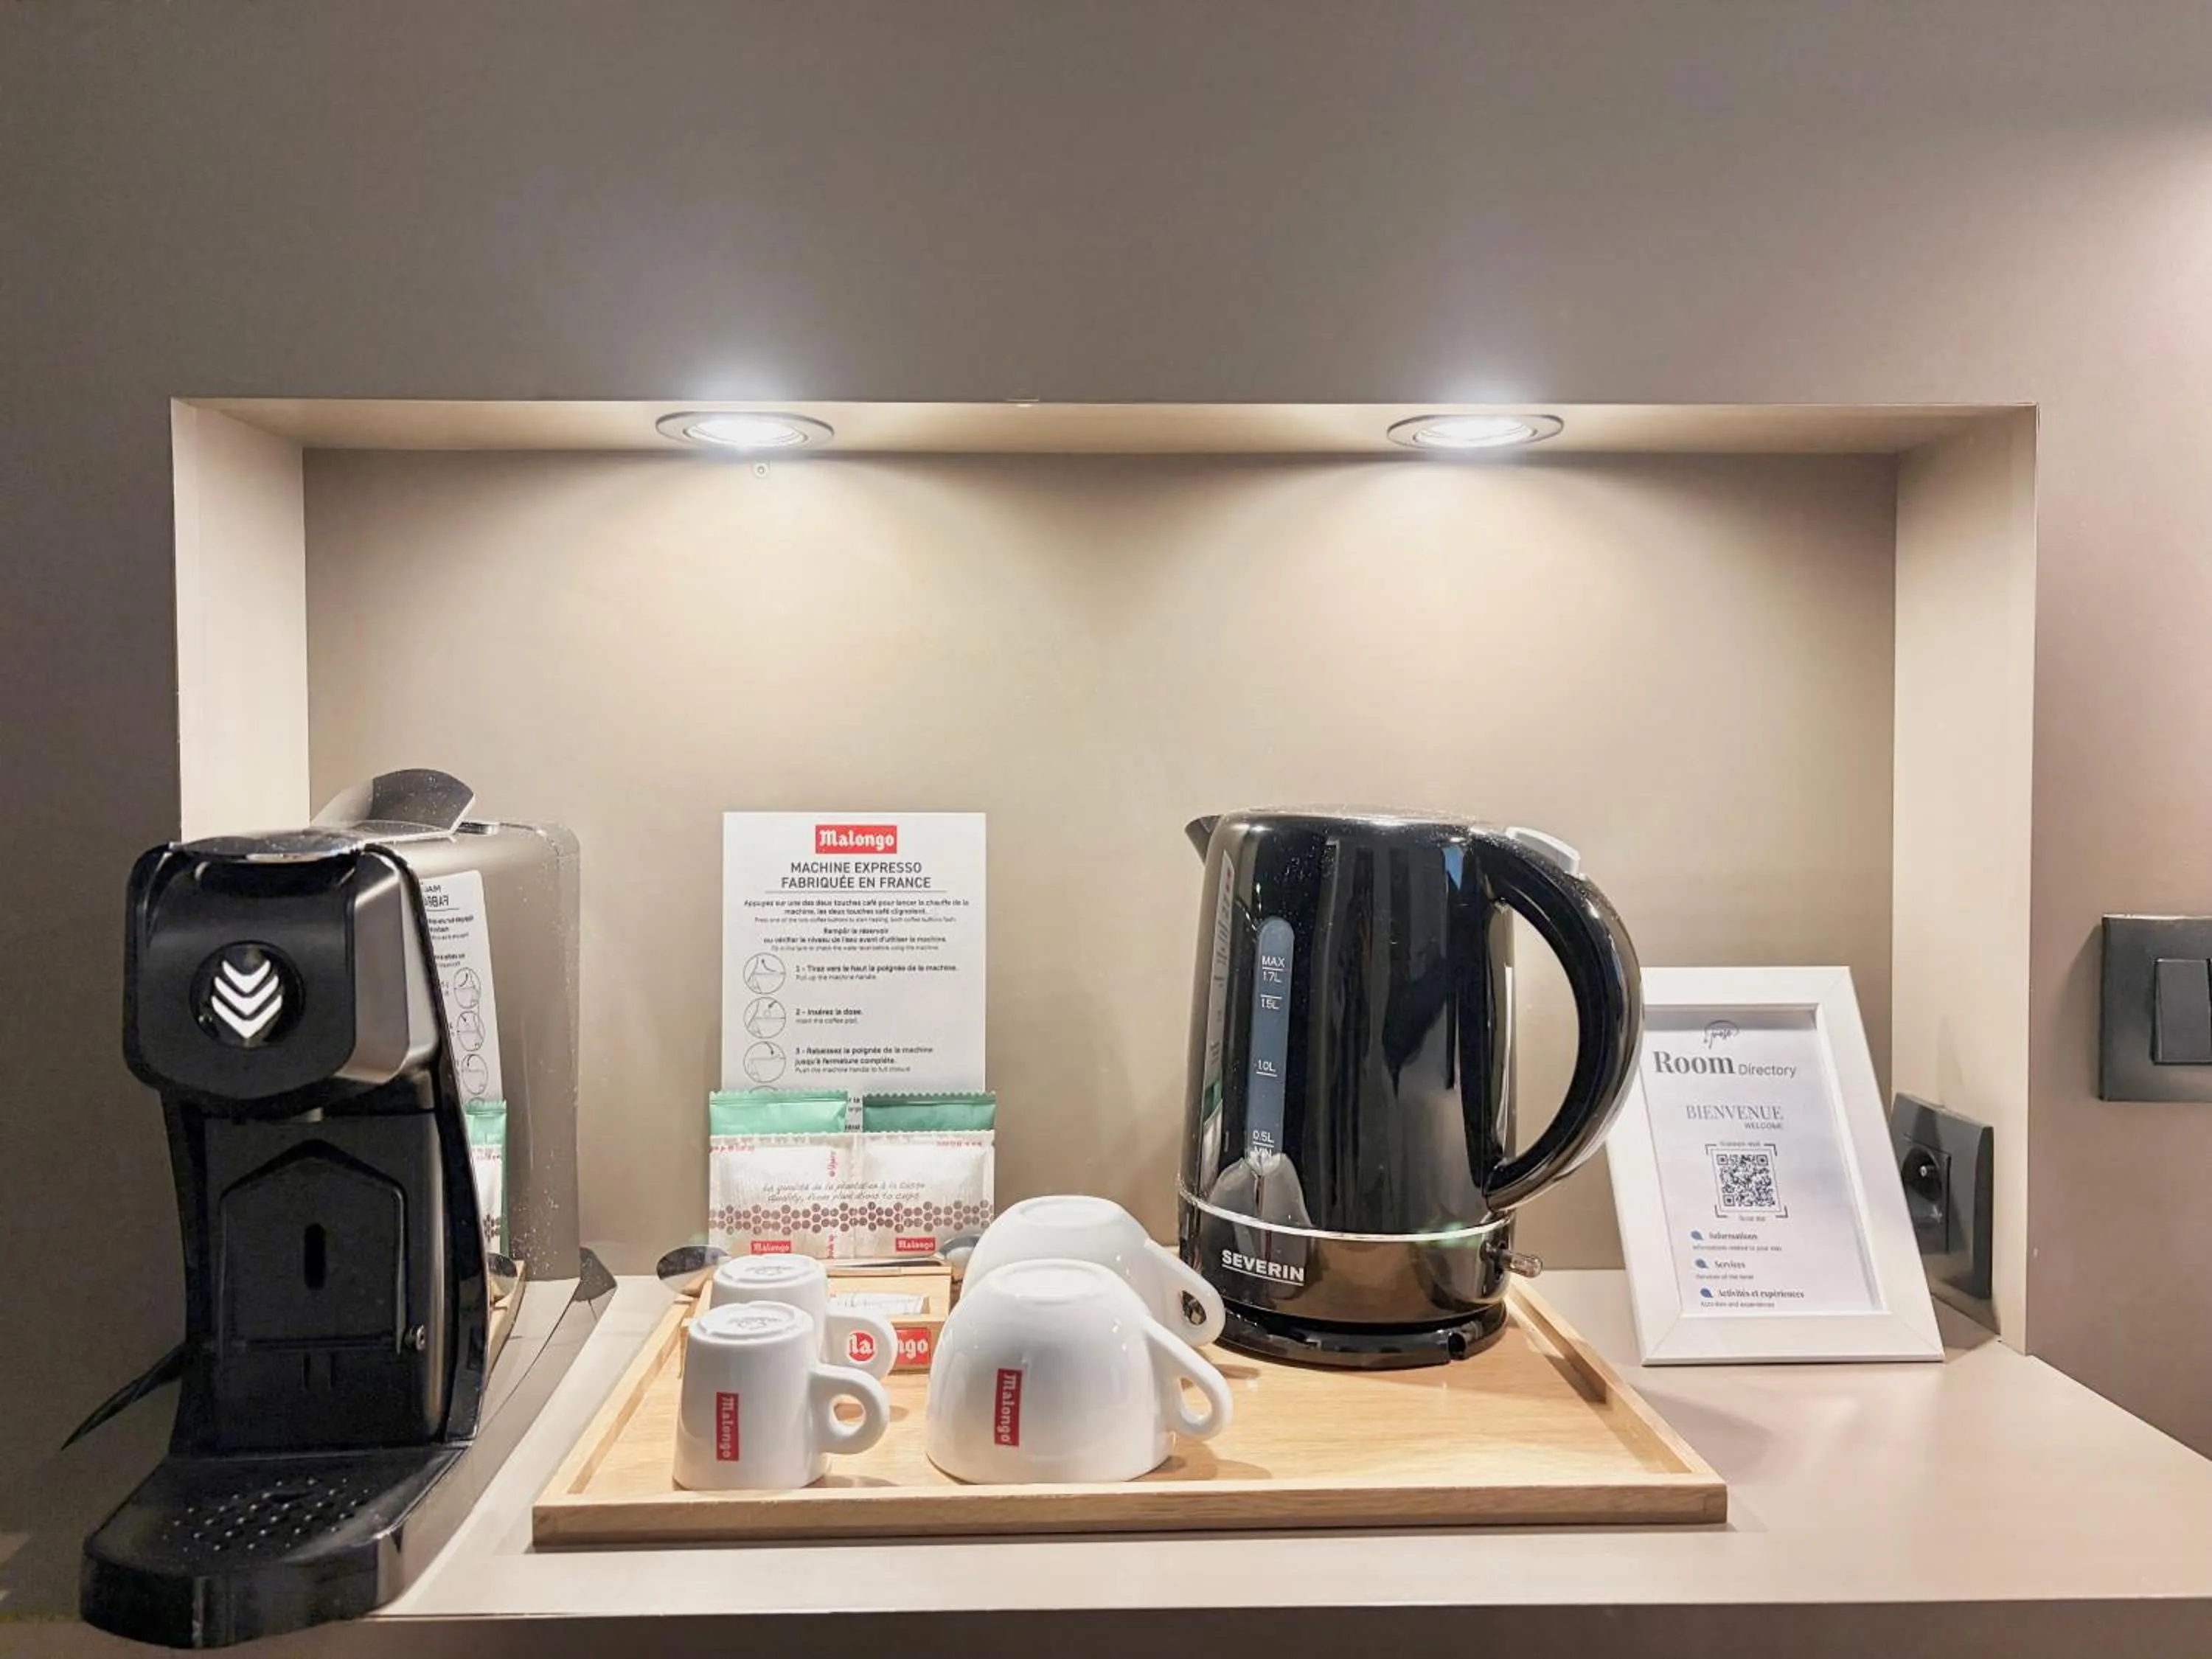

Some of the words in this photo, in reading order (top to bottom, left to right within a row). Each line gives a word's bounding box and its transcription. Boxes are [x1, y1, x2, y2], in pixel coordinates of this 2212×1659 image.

[818, 829, 894, 852] Malongo
[790, 861, 850, 874] MACHINE
[855, 861, 922, 874] EXPRESSO
[781, 874, 855, 888] FABRIQUÉE
[859, 876, 875, 888] EN
[880, 876, 931, 888] FRANCE
[1262, 955, 1285, 967] MAX
[1652, 1050, 1736, 1074] Room
[1738, 1062, 1797, 1078] Directory
[1686, 1105, 1784, 1121] BIENVENUE
[754, 1242, 790, 1253] Malongo
[897, 1239, 934, 1250] Malongo
[1222, 1248, 1304, 1282] SEVERIN
[997, 1371, 1017, 1444] Malongo
[719, 1395, 734, 1458] Malongo
